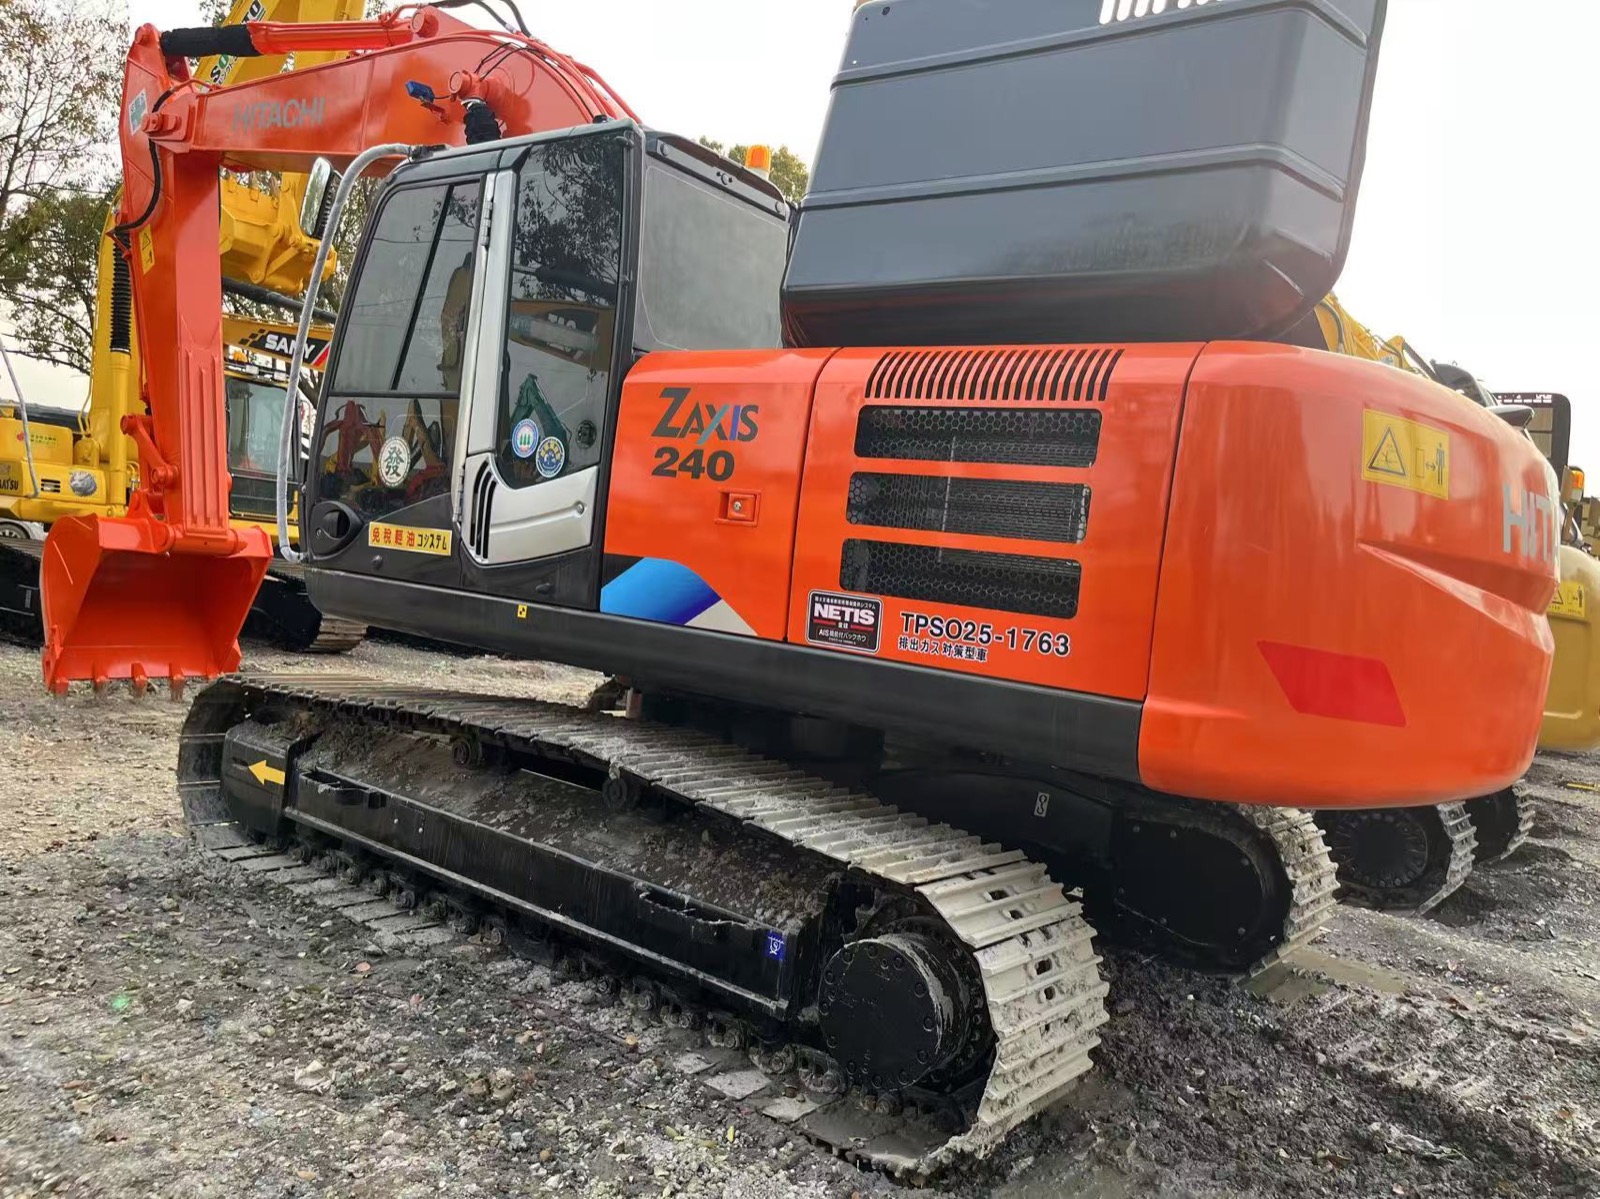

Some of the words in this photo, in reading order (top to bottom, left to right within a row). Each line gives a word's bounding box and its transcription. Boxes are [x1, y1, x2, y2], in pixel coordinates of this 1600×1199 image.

[231, 96, 325, 135] HITACHI
[651, 387, 759, 445] ZAXIS
[651, 446, 735, 482] 240
[0, 479, 19, 491] ATSU
[1503, 484, 1557, 563] HIT
[814, 603, 875, 625] NETIS
